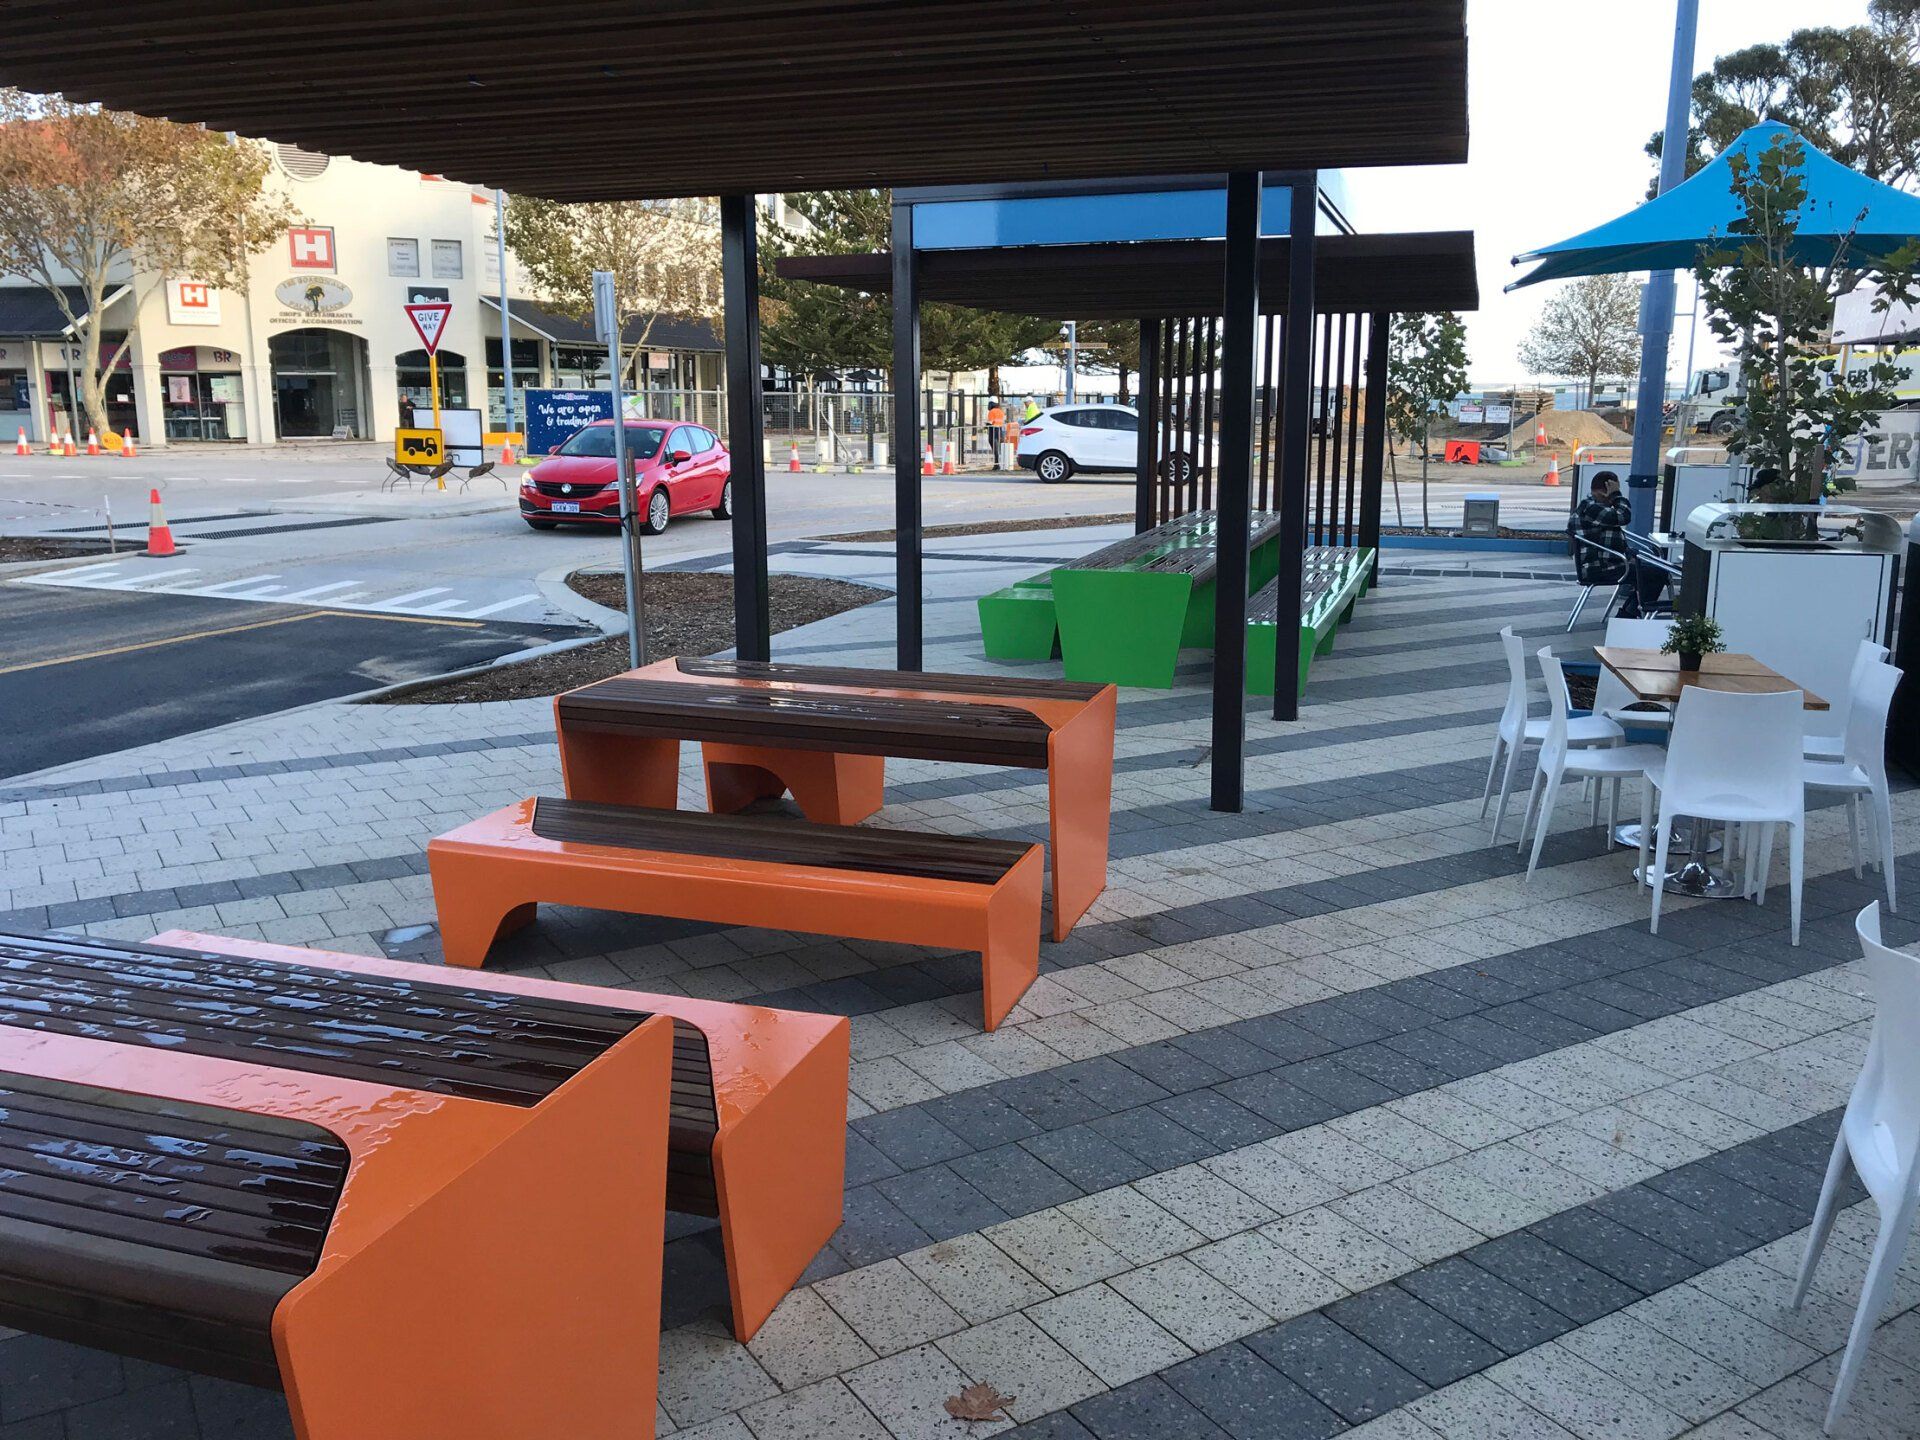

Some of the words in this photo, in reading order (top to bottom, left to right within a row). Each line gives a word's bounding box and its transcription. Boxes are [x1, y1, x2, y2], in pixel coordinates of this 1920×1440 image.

[294, 234, 328, 261] H
[183, 286, 207, 303] H
[418, 312, 440, 322] GIVE
[422, 323, 437, 331] WAY
[213, 350, 232, 362] BR
[538, 403, 554, 414] We
[557, 404, 575, 415] are
[578, 404, 601, 414] open
[546, 416, 554, 426] &
[1866, 432, 1920, 470] ER
